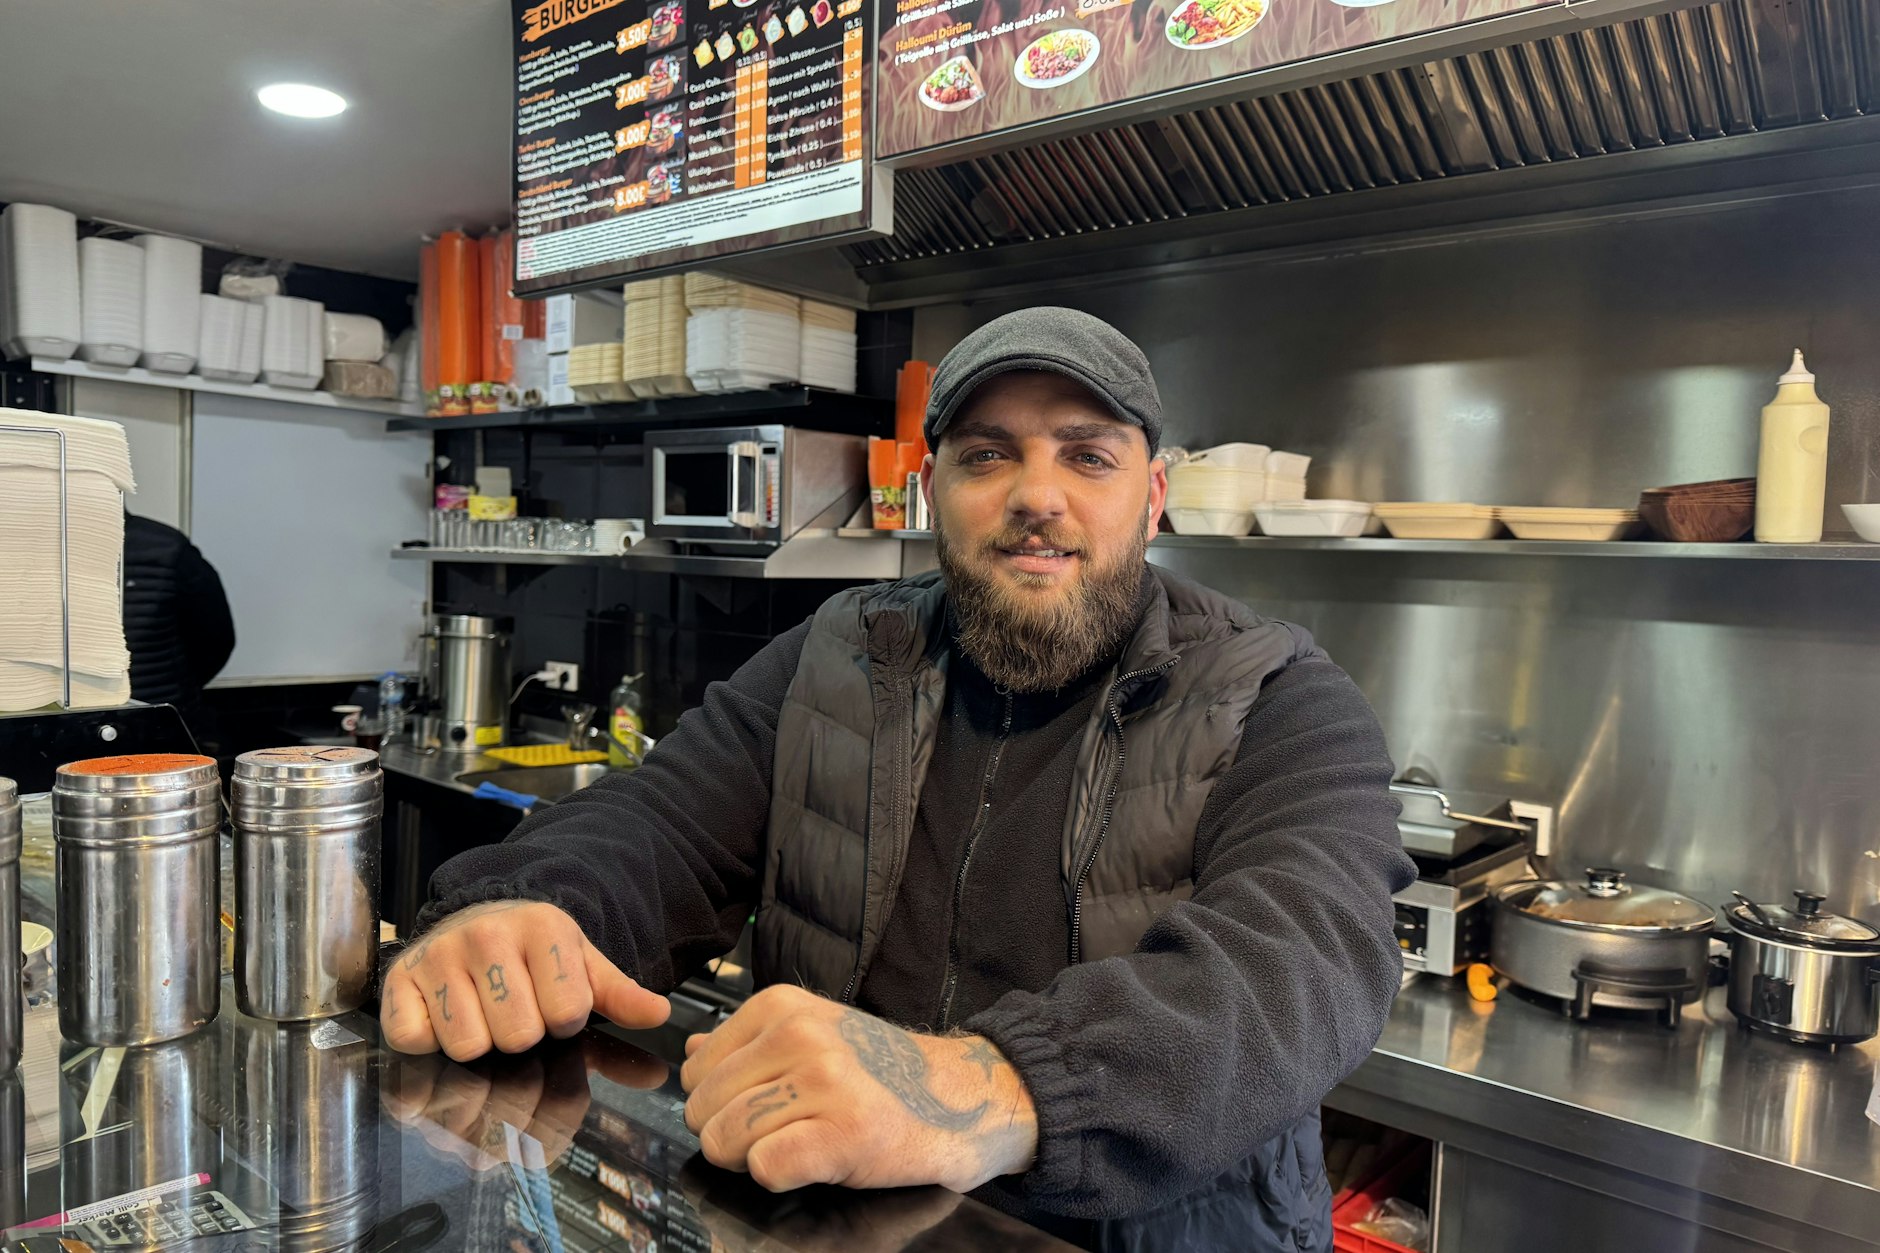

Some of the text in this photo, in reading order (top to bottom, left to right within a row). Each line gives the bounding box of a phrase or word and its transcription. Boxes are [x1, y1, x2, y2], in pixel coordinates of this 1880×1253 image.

[619, 25, 648, 49] 6.50€
[896, 21, 972, 52] Halloumi Dürüm
[900, 46, 935, 65] Teigrolle
[935, 42, 950, 53] mit
[992, 23, 1014, 37] Salat
[1014, 16, 1034, 31] und
[1034, 10, 1060, 24] Soße
[689, 78, 720, 94] Coca Cola
[768, 74, 794, 88] Wasser
[619, 82, 648, 104] 7.00€
[689, 98, 705, 111] Coca
[705, 93, 720, 107] Cola
[768, 92, 788, 107] Ayran
[618, 126, 647, 148] 8.00€
[617, 186, 646, 207] 8.00€
